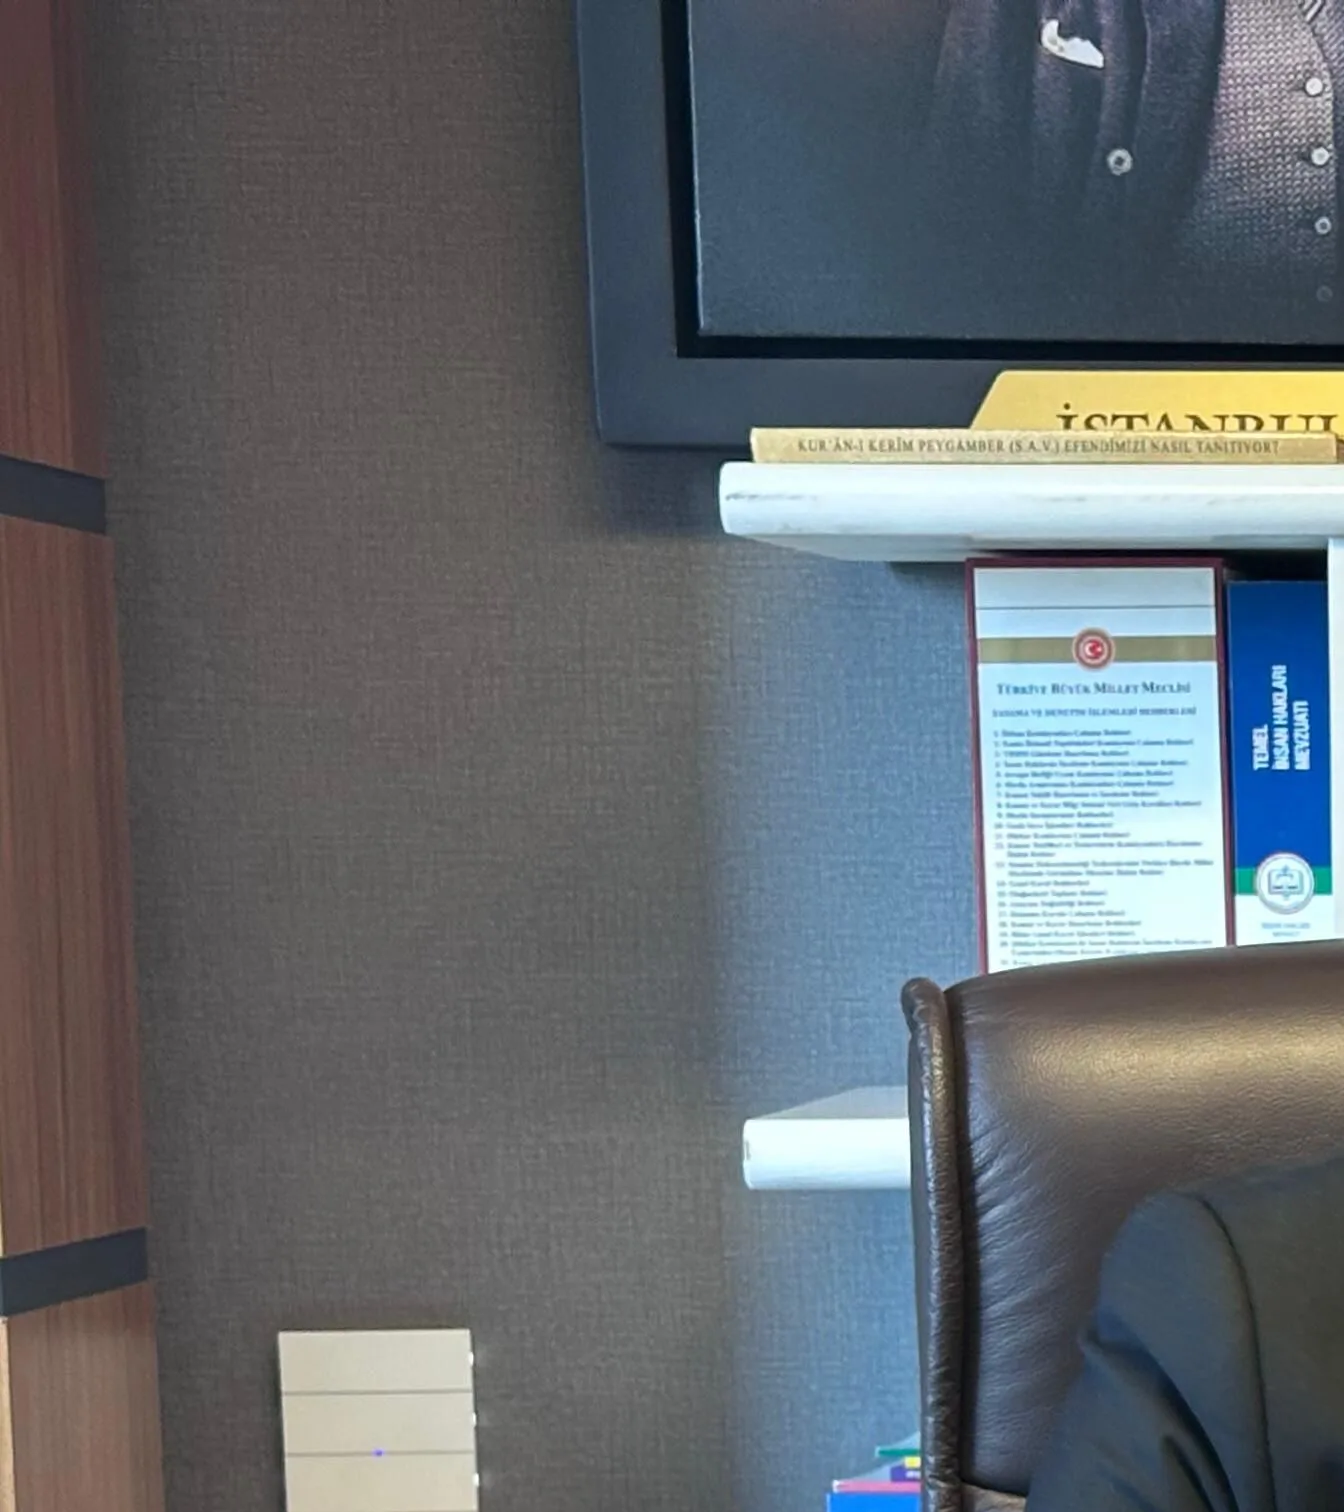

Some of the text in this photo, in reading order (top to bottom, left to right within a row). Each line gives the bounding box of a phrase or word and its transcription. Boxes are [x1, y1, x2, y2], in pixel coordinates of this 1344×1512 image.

[867, 437, 914, 455] KERİM
[918, 437, 1005, 455] PEYGAMBER
[1151, 437, 1194, 455] NASIL
[1271, 664, 1289, 770] İNSAN HAKLARI
[1292, 700, 1310, 770] MEVZUATI
[1252, 724, 1269, 771] TEMEL
